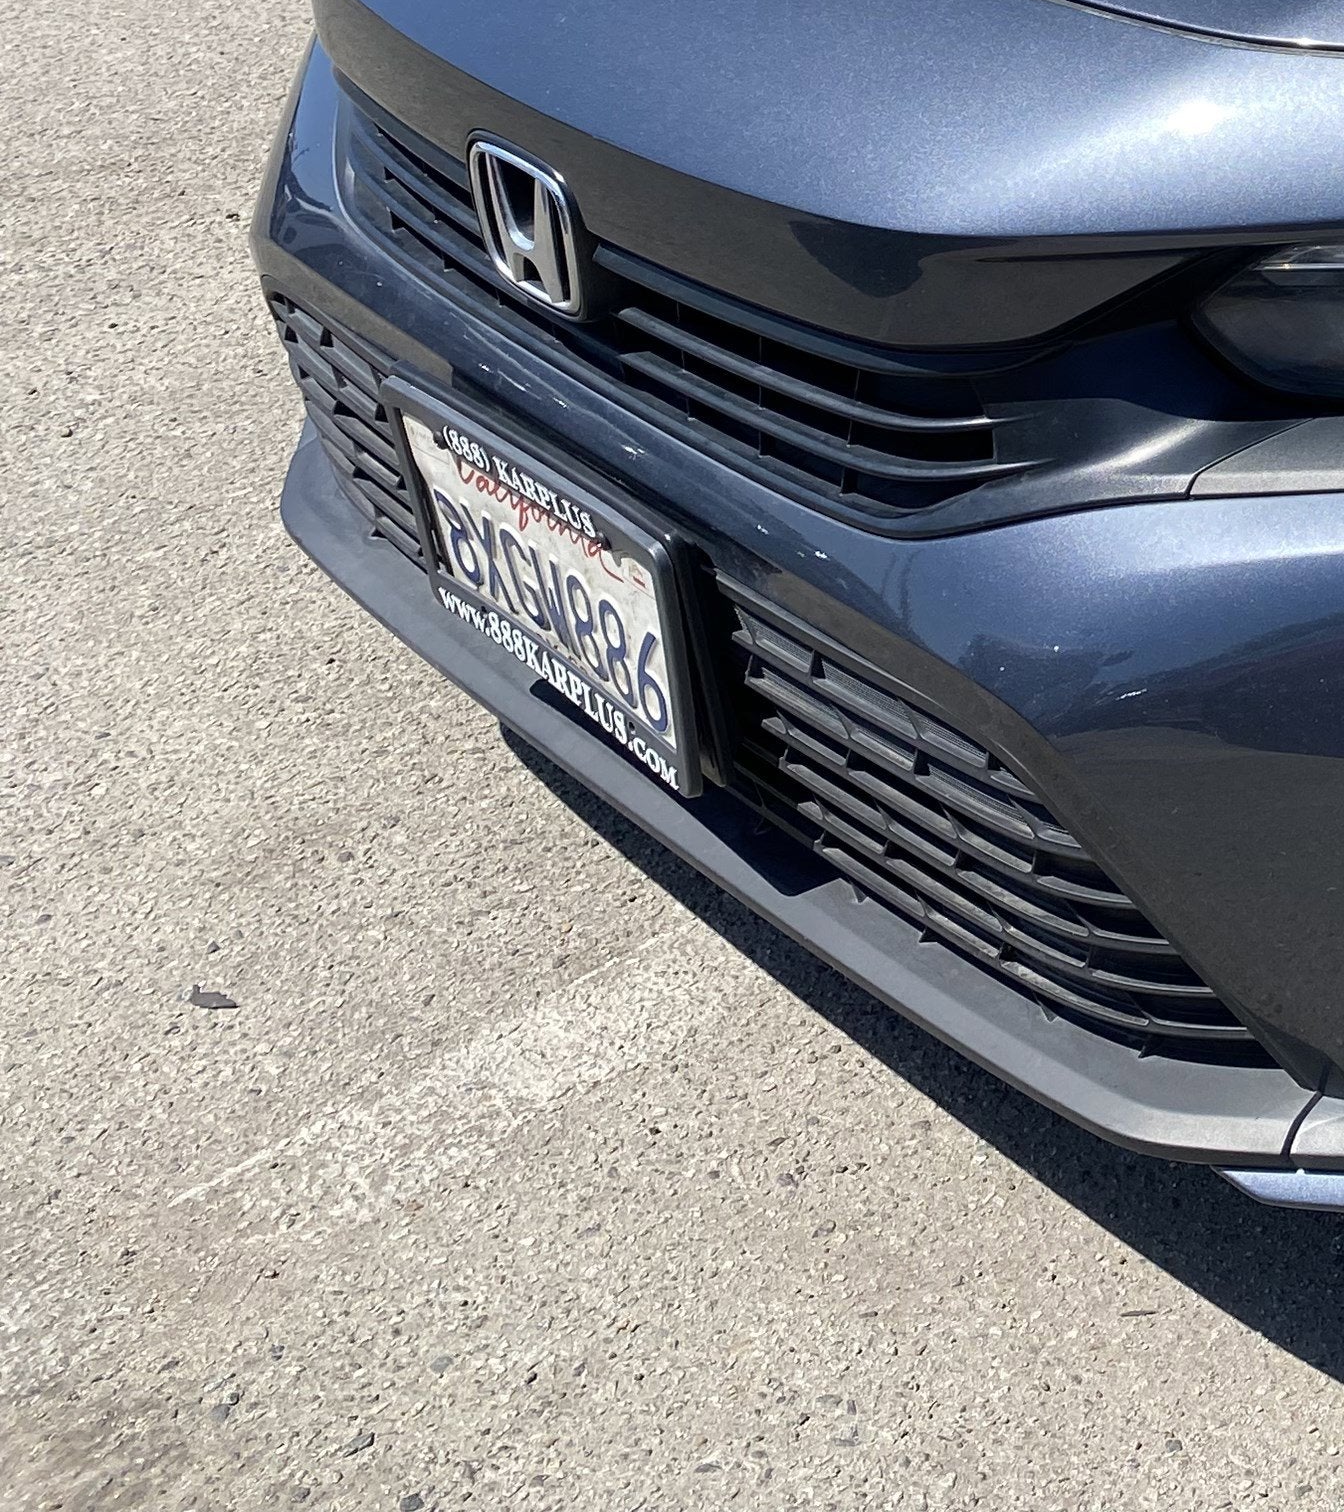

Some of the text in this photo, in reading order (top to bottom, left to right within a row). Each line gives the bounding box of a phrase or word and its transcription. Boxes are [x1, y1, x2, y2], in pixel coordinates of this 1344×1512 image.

[442, 425, 596, 538] (888) KARPLUS
[430, 486, 669, 734] 8XGW886
